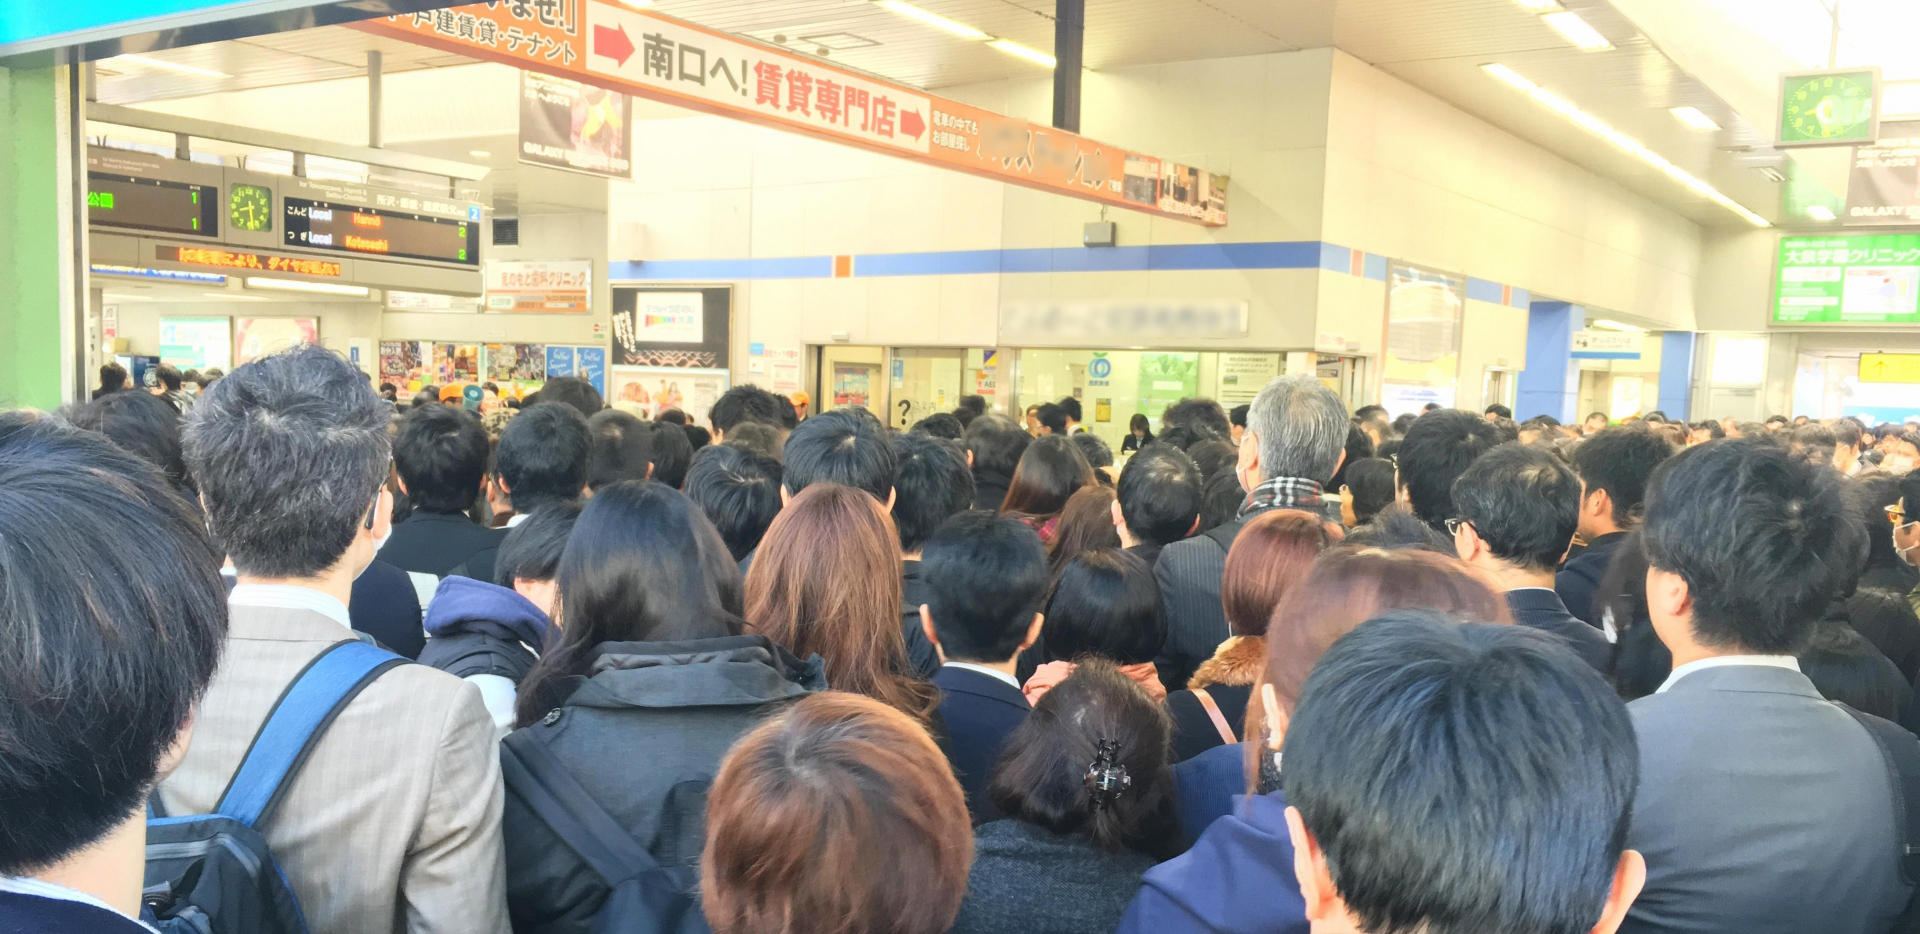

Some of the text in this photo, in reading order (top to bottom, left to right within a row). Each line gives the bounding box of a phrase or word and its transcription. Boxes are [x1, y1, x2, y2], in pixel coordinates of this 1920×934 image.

[932, 110, 979, 136] 電車の中でも
[932, 129, 970, 153] お部屋探し
[191, 191, 199, 204] 1
[191, 217, 199, 230] 1
[287, 205, 308, 217] こんど
[309, 206, 333, 222] Local
[458, 226, 467, 238] 2
[1849, 206, 1906, 217] GALAXY
[309, 230, 333, 246] Local
[458, 248, 467, 261] 2
